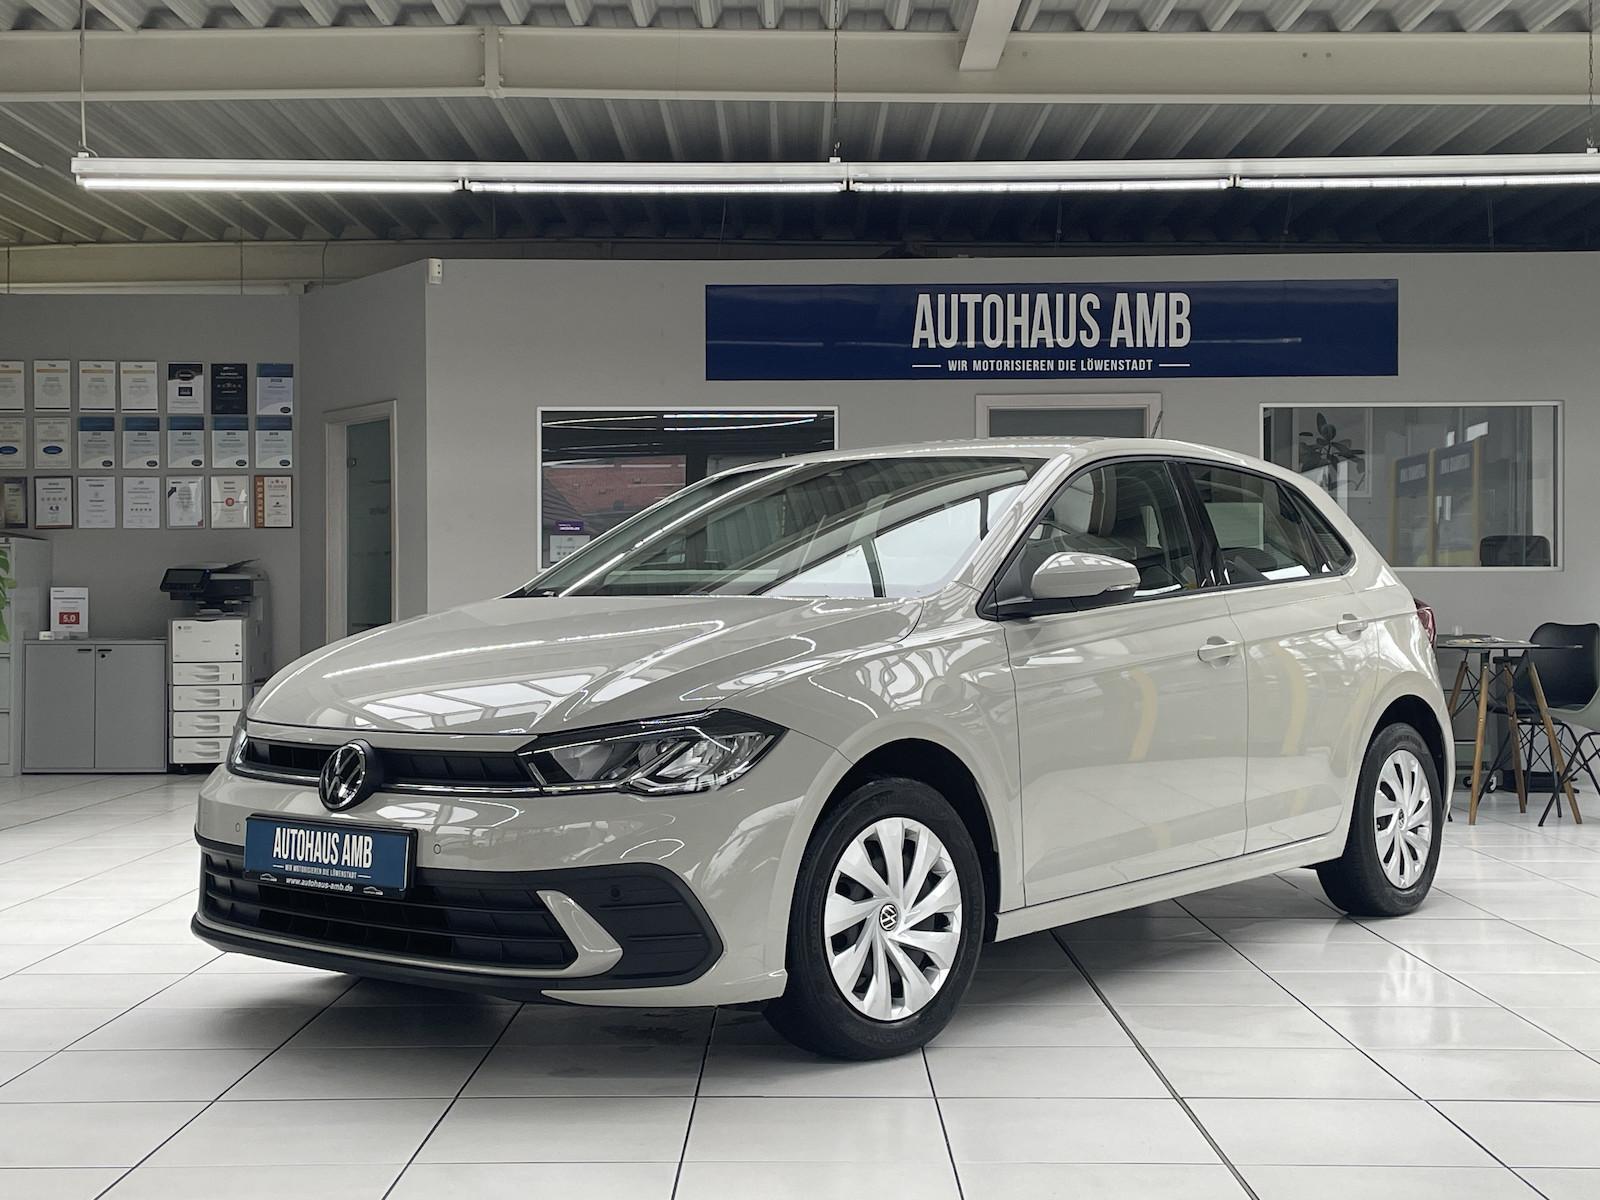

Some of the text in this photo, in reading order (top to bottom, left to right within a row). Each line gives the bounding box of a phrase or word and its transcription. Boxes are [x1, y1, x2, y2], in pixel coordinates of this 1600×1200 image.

[912, 292, 1191, 348] AUTOHAUS AMB
[948, 357, 1153, 372] WIR MOTORISIEREN DIE LÖWENSTADT
[273, 827, 373, 868] AUTOHAUS AMB
[286, 878, 353, 892] www.autohaus-amb.de
